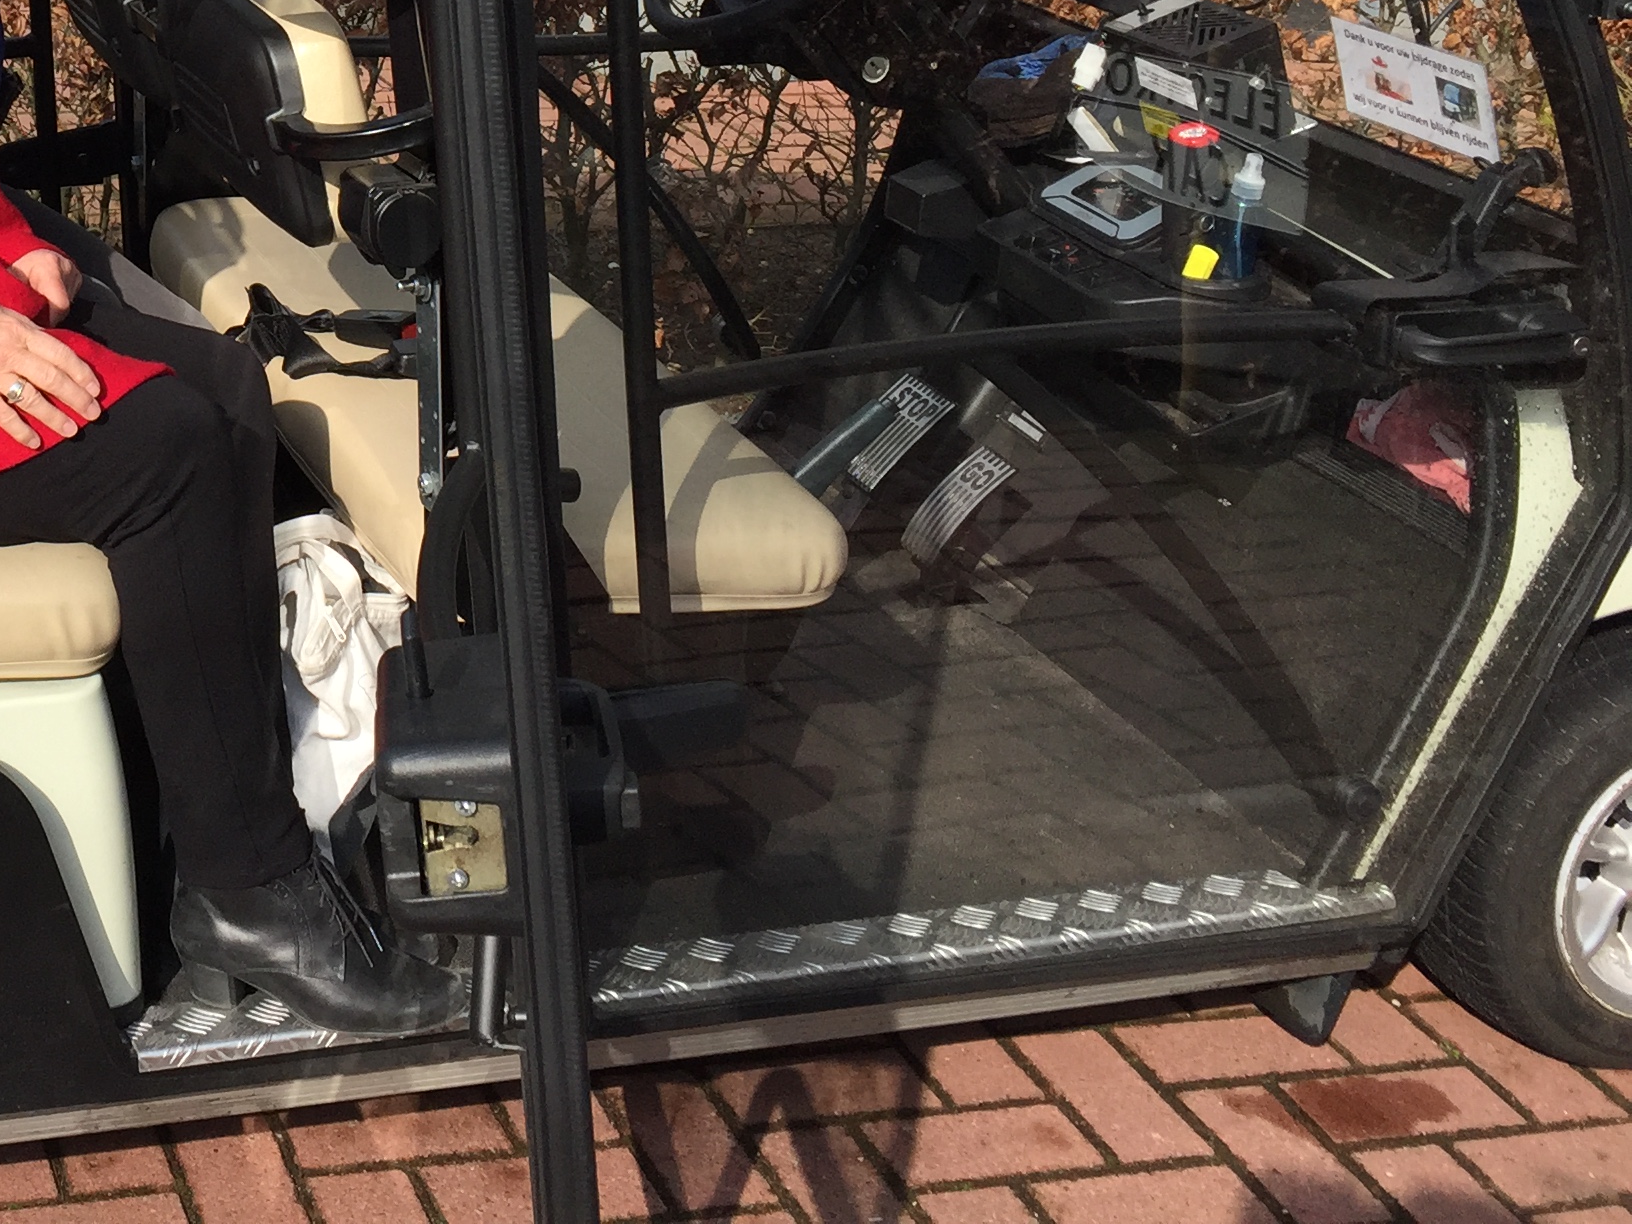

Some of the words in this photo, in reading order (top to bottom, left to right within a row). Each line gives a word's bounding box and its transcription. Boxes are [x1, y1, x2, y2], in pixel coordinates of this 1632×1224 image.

[1344, 29, 1366, 44] Dank
[1375, 41, 1394, 53] voor
[1396, 48, 1410, 59] uw
[1411, 49, 1448, 73] bijdrage
[1449, 65, 1475, 82] zodat
[1353, 93, 1367, 105] wij
[1367, 97, 1387, 110] voor
[1396, 107, 1428, 128] kunnen
[1430, 119, 1461, 139] blijven
[1462, 132, 1489, 150] rijden
[892, 387, 939, 422] STOP
[959, 461, 995, 491] GO
